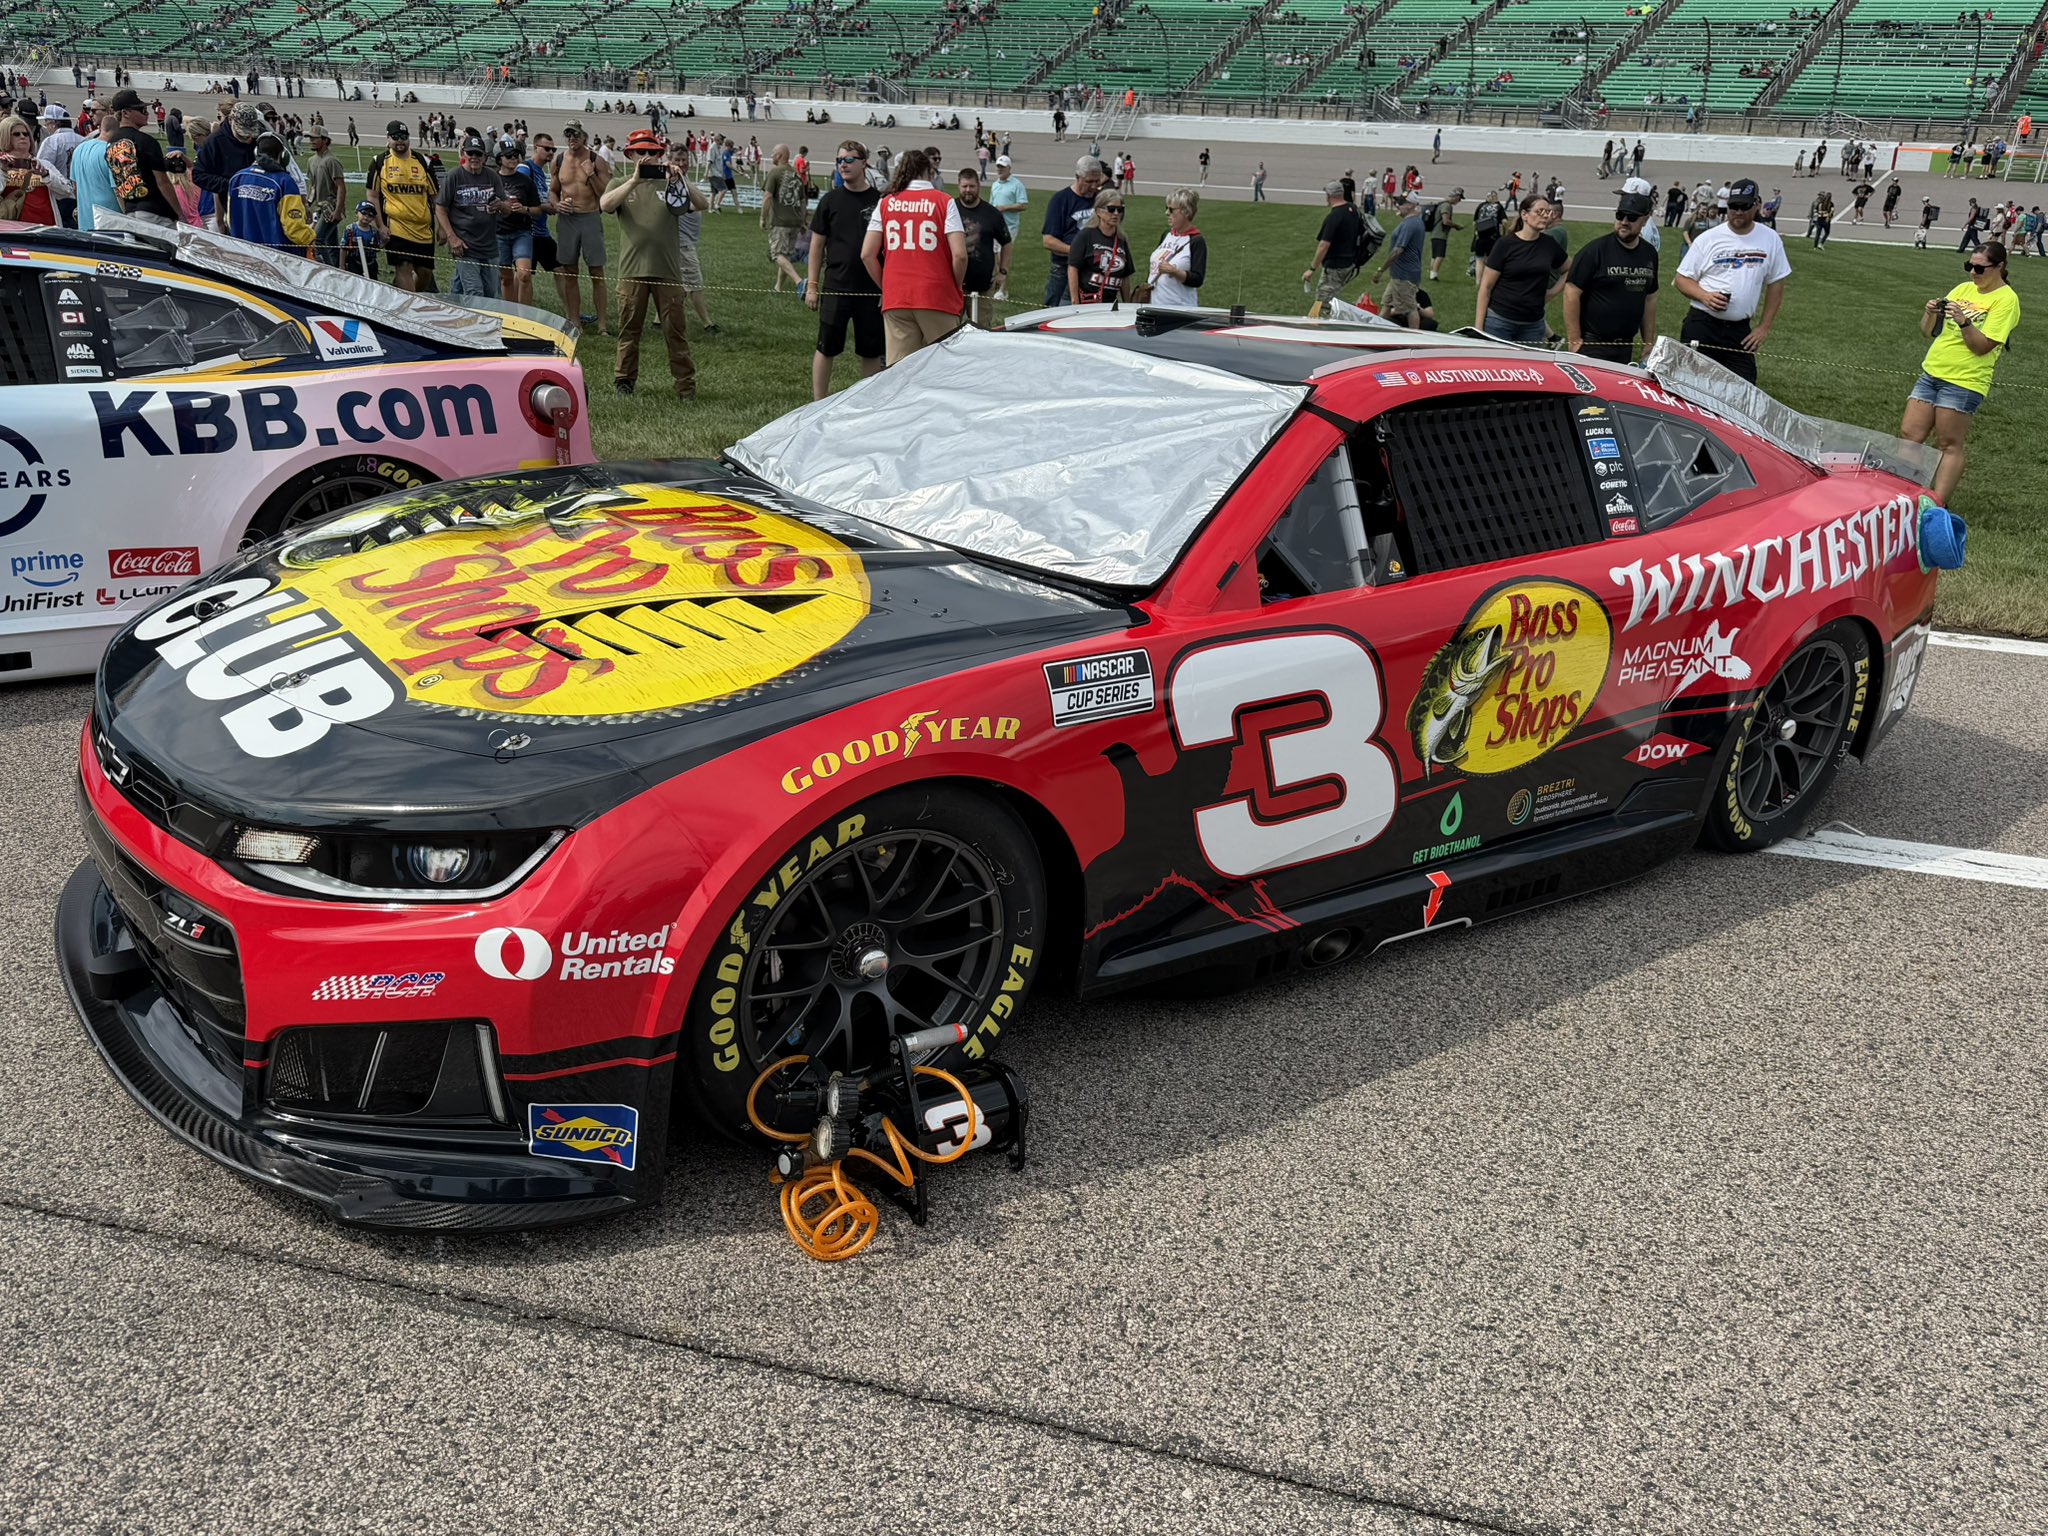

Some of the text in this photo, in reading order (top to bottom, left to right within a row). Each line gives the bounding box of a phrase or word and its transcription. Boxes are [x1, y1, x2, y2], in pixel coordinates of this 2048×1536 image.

[887, 197, 936, 216] Security
[886, 219, 938, 251] 616
[1607, 266, 1629, 276] KYLE
[66, 343, 95, 356] MAC
[326, 344, 375, 356] Valvoline
[90, 382, 497, 459] KBB.com
[1585, 427, 1614, 437] LUCAS OIL
[1608, 461, 1625, 475] ptc
[11, 550, 84, 577] prime
[113, 550, 196, 576] Coca-Cola
[1608, 494, 1917, 634] WINCHESTER
[1502, 592, 1580, 649] Bass
[1622, 635, 1714, 667] MAGNUM
[134, 577, 394, 758] CLUB
[1080, 656, 1135, 681] NASCAR
[1497, 645, 1556, 698] Pro
[1617, 655, 1733, 687] PHEASANT
[1067, 682, 1141, 711] CUP SERIES
[1846, 656, 1869, 734] EAGLE
[1485, 690, 1582, 750] Shops
[781, 709, 1021, 794] GOODYEAR
[1171, 633, 1397, 878] 3
[1637, 743, 1690, 763] DOW
[1537, 778, 1575, 796] BREZTRI
[1412, 834, 1482, 865] GET BIOETHANOL
[163, 911, 206, 939] ZL1
[561, 925, 668, 956] United
[560, 949, 675, 982] Rentals
[962, 943, 1034, 1062] EAGLE
[534, 1123, 634, 1148] SUNOCO
[924, 1099, 993, 1156] 3
